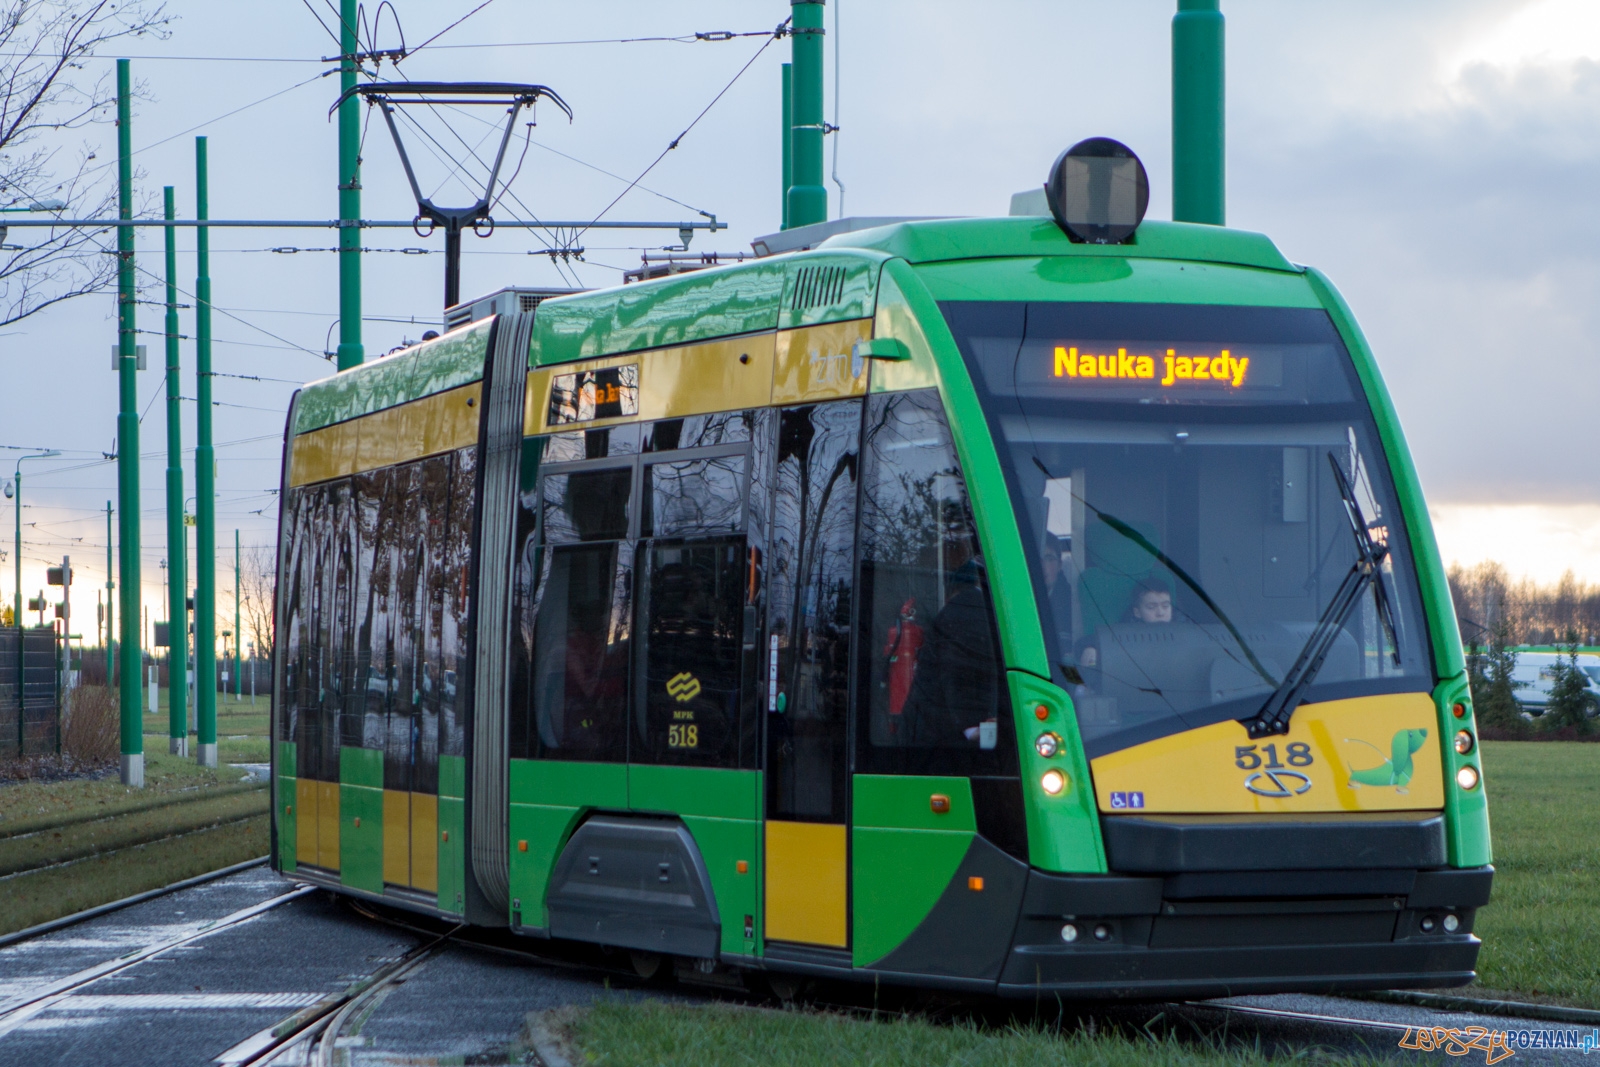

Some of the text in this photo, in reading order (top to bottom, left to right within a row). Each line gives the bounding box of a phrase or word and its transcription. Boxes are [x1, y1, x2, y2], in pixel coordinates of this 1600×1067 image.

[1054, 347, 1249, 387] Nauka jazdy
[673, 711, 694, 719] MPK
[668, 724, 698, 747] 518
[1234, 741, 1314, 770] 518
